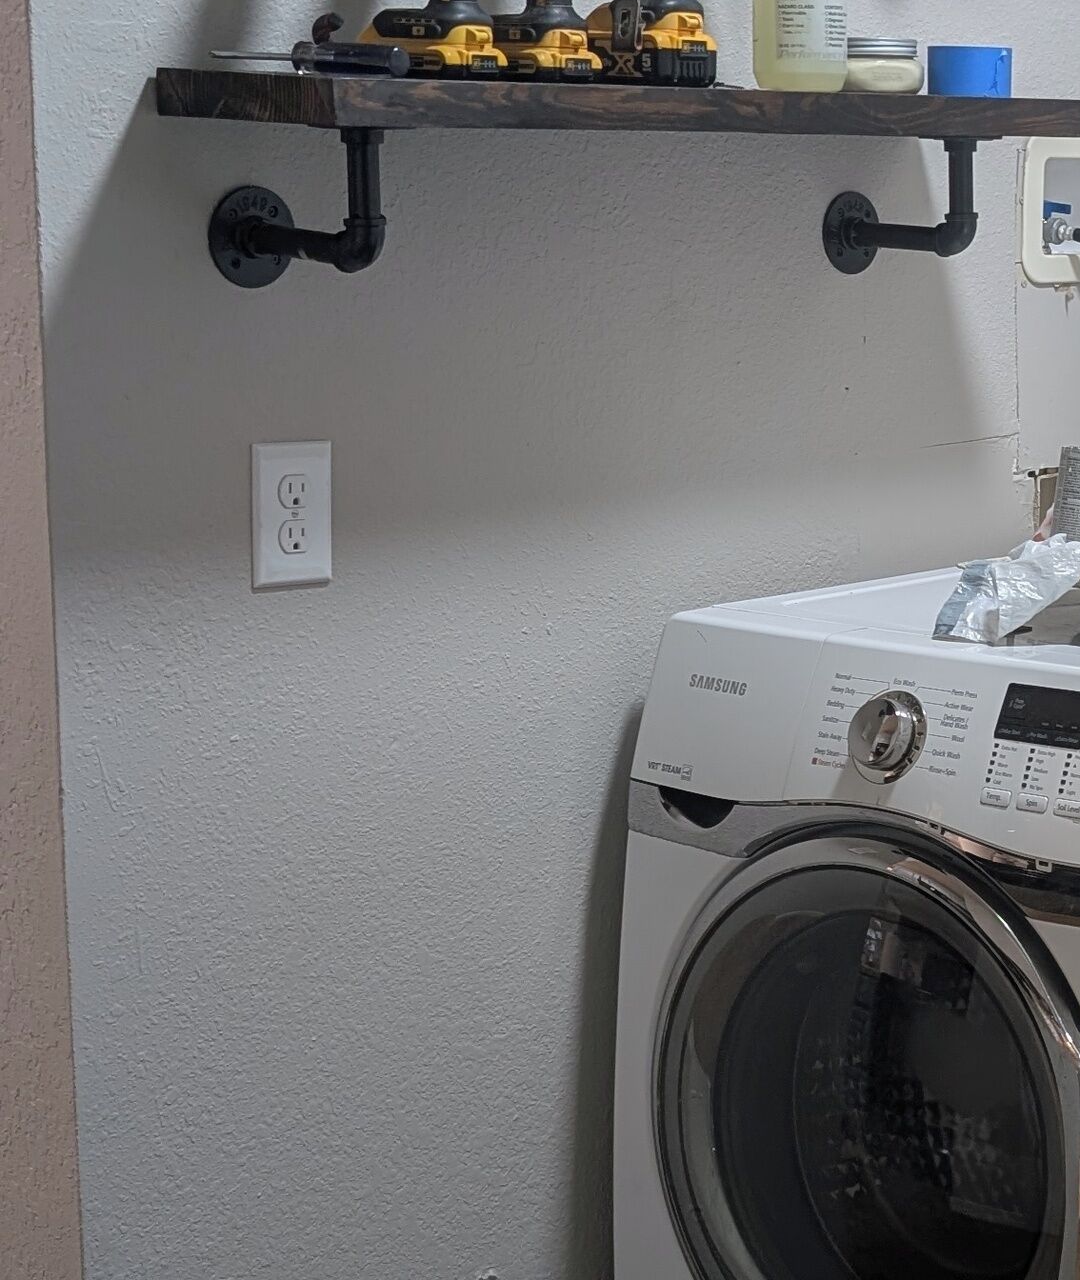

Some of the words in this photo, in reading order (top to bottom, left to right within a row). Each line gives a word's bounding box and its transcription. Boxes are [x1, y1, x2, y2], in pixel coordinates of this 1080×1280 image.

[689, 673, 748, 696] SAMSUNG
[902, 678, 916, 687] Wash
[830, 685, 845, 695] Heavy
[845, 688, 856, 696] Duty
[826, 699, 845, 710] Bedding
[940, 720, 954, 728] Hand
[954, 722, 969, 730] Wash
[830, 732, 842, 742] Away
[814, 747, 825, 757] Deep
[932, 748, 945, 758] Quick
[946, 751, 961, 760] Wash
[661, 763, 681, 775] STEAM
[1025, 799, 1037, 808] Spin
[1057, 803, 1066, 812] Soil
[1066, 805, 1080, 814] Level
